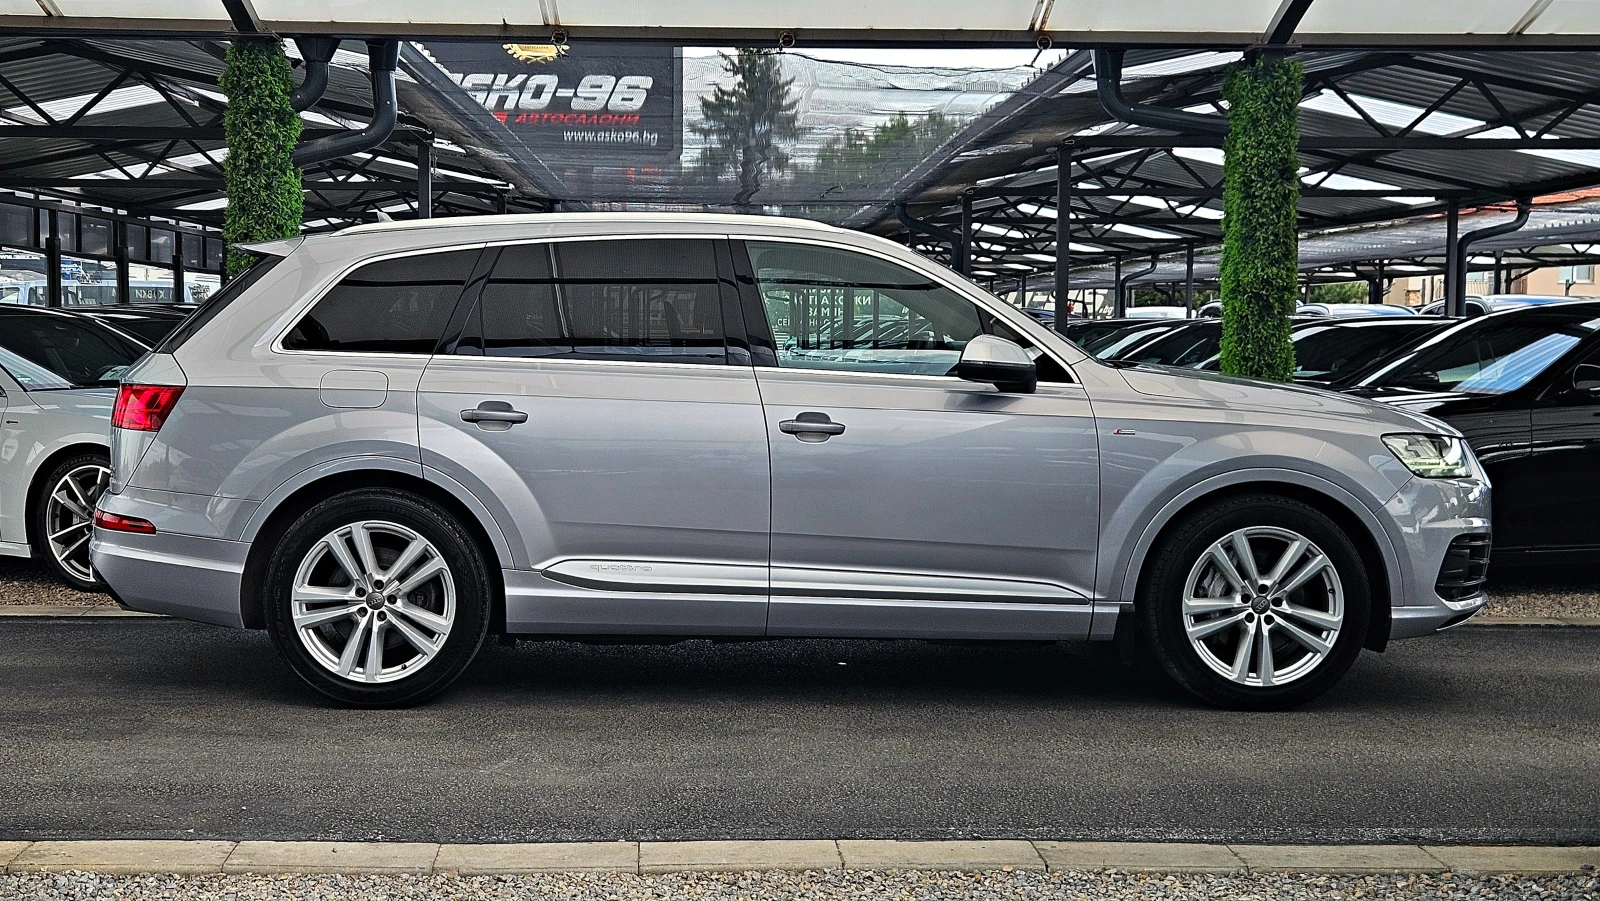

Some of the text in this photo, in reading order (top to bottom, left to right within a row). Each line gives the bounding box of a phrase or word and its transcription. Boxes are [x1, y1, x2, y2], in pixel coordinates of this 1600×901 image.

[514, 112, 640, 125] АВТОСАЛОНИ
[562, 128, 659, 145] www.asko96.bg
[588, 564, 653, 572] quattro
